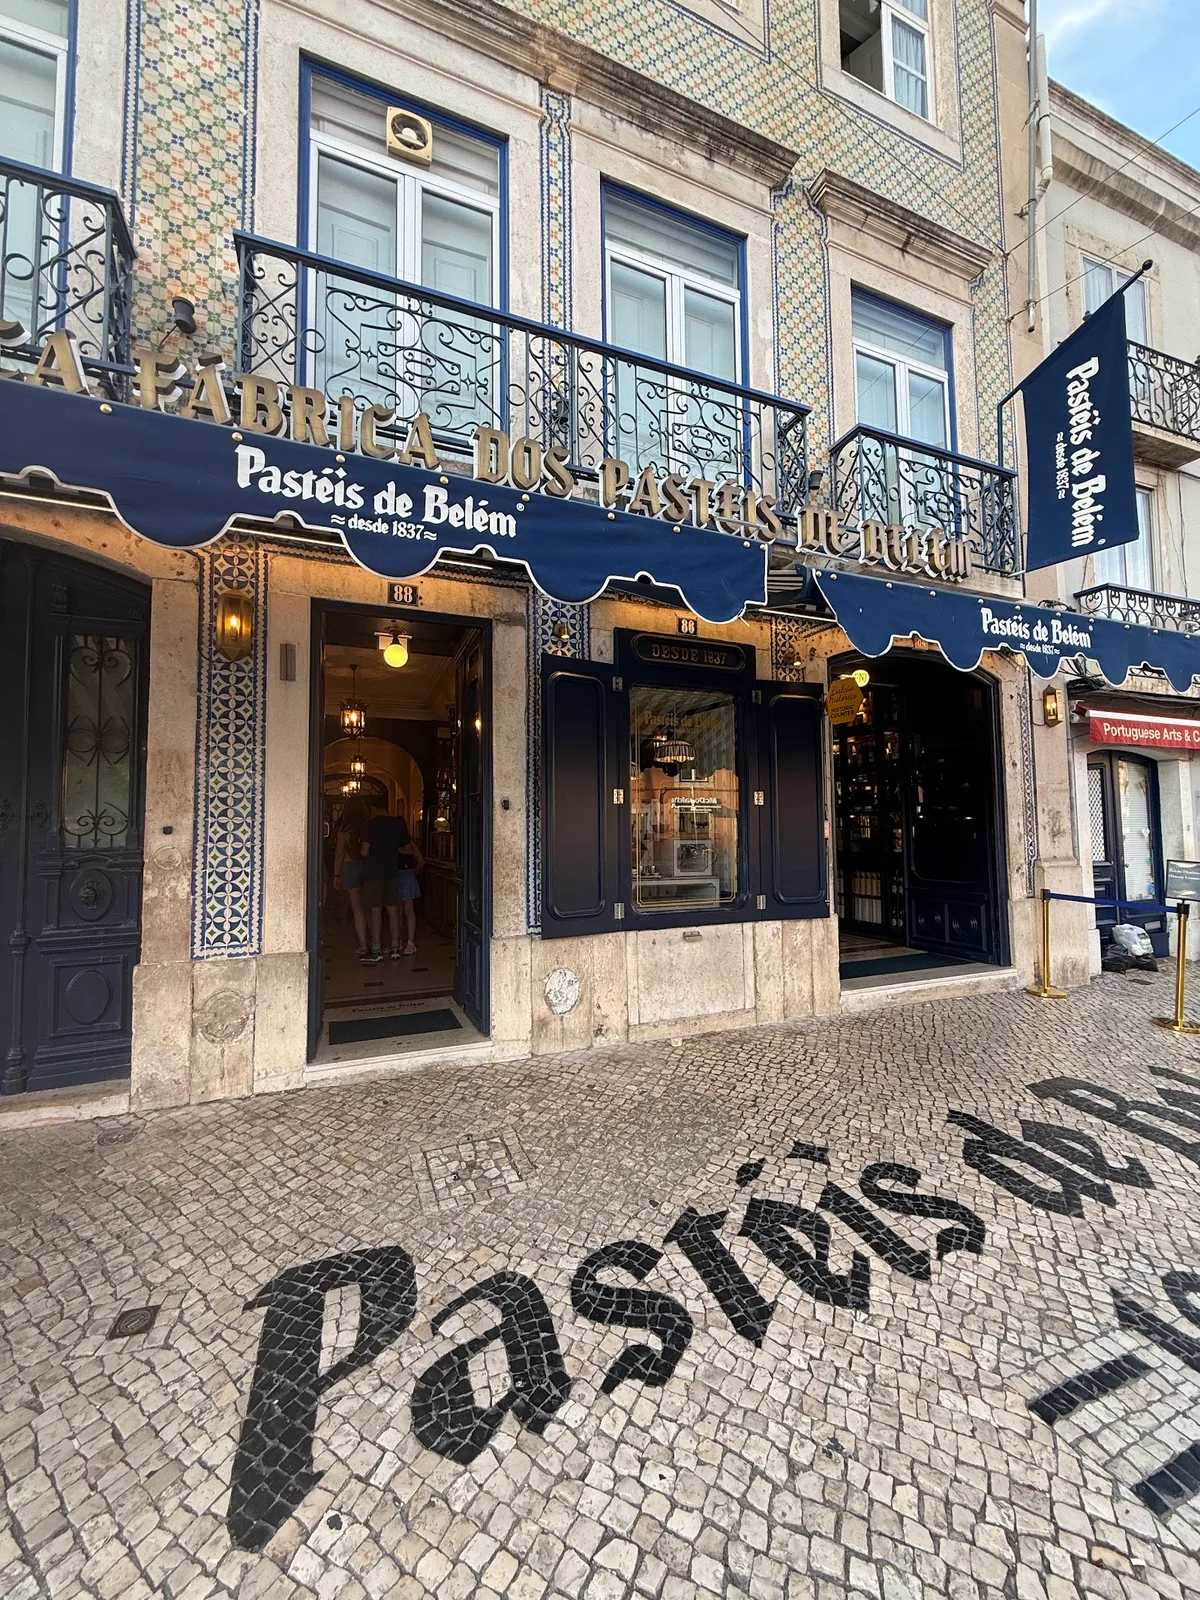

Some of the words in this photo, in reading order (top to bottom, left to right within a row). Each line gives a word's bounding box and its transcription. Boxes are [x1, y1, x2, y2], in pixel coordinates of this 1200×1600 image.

[1065, 356, 1101, 446] Pastéis
[1055, 441, 1069, 469] desde
[1070, 447, 1101, 477] de
[235, 444, 365, 510] Pastéis
[373, 481, 413, 518] de
[421, 484, 517, 538] Belém
[473, 425, 573, 498] DOS
[797, 504, 852, 556] DE
[1056, 468, 1070, 490] 1837
[1071, 474, 1107, 548] Belém
[348, 513, 389, 535] desde
[392, 520, 425, 541] 1837
[393, 584, 413, 603] 88
[681, 618, 695, 634] 86
[981, 607, 1030, 640] Pastéis
[1033, 620, 1049, 643] de
[1051, 619, 1092, 649] Belém
[651, 643, 699, 661] DESDE
[703, 649, 727, 665] 1837
[1026, 642, 1042, 653] desde
[1042, 645, 1055, 656] 1837
[830, 710, 855, 719] COUNTER
[831, 704, 855, 713] HISTORIC
[1103, 722, 1161, 741] Portuguese
[1163, 727, 1183, 742] Arts
[1184, 729, 1192, 742] &
[227, 1140, 986, 1552] Pastéis
[947, 1109, 1157, 1219] de
